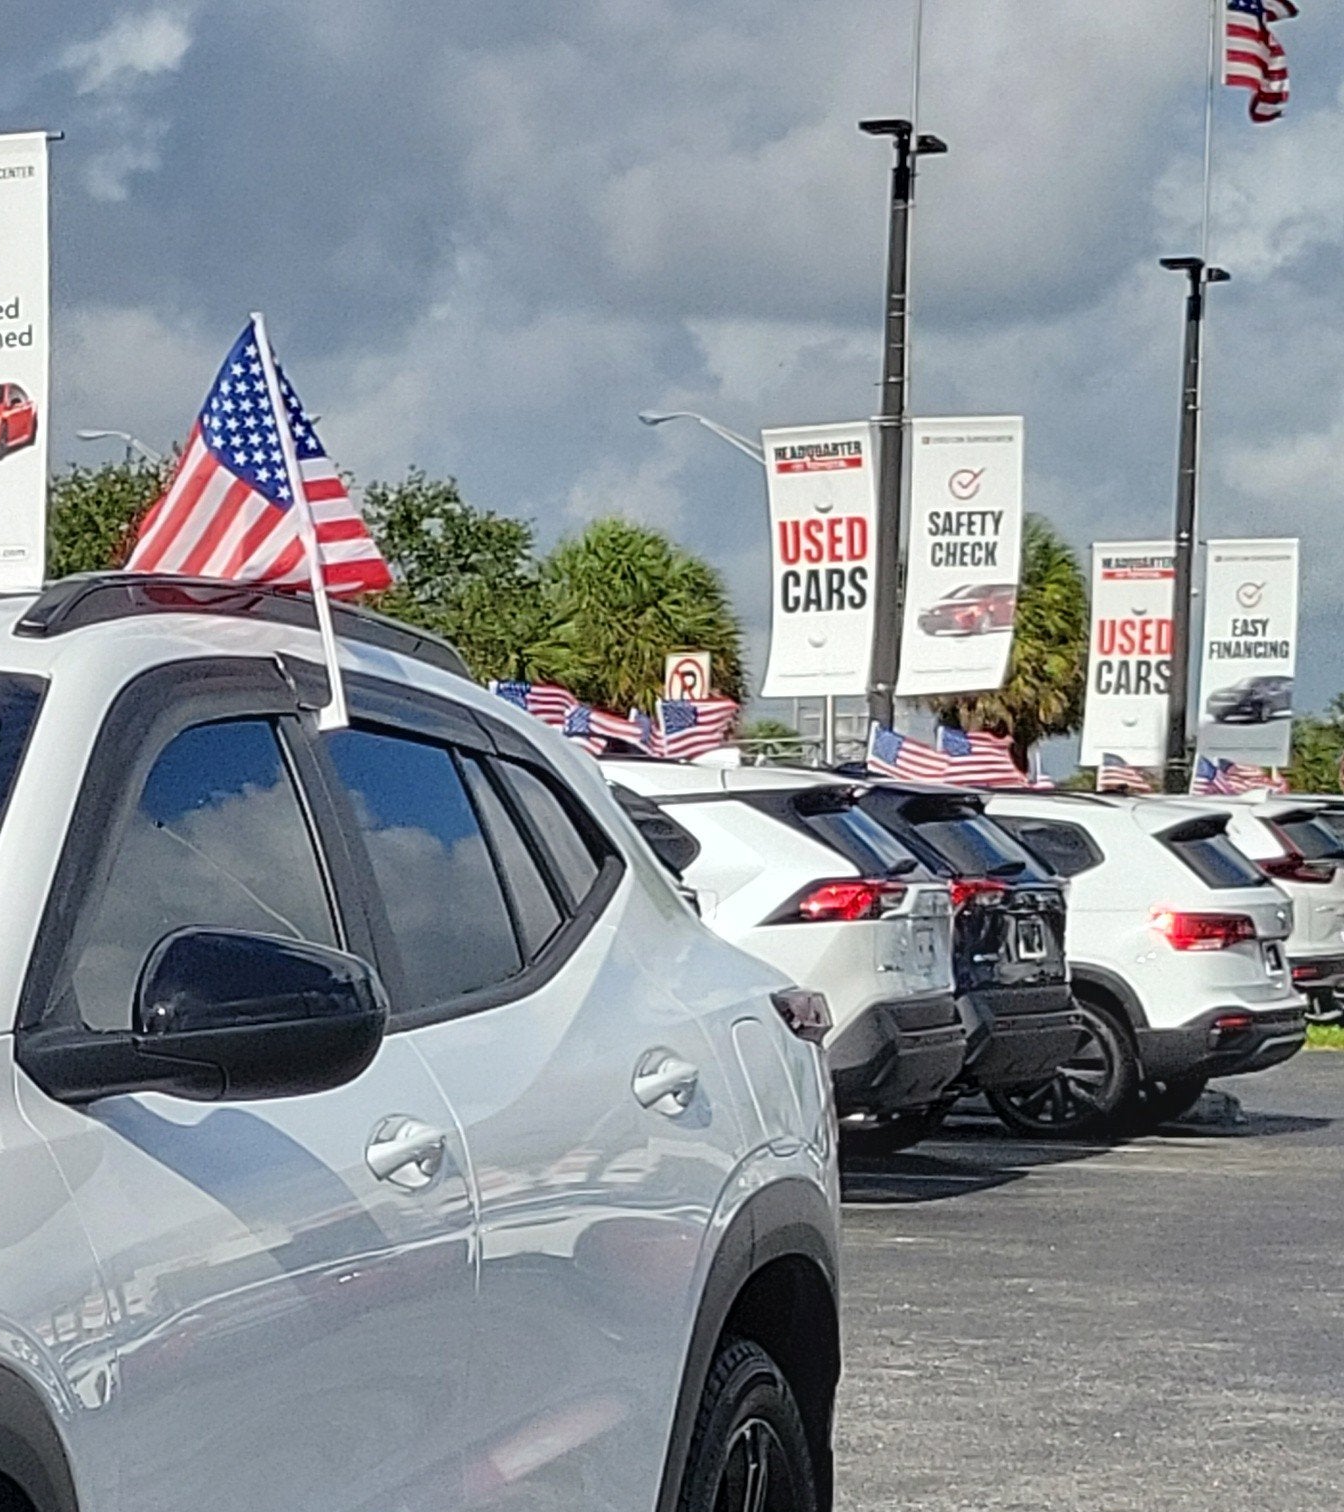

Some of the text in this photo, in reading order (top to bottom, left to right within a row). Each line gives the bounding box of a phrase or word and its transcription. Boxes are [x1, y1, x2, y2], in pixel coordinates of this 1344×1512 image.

[927, 510, 1004, 536] SAFETY
[778, 516, 868, 566] USED
[931, 541, 998, 567] CHECK
[780, 565, 869, 614] CARS
[1098, 619, 1175, 656] USED
[1231, 618, 1269, 638] EASY
[1208, 640, 1290, 660] FINANCING
[1094, 659, 1173, 696] CARS
